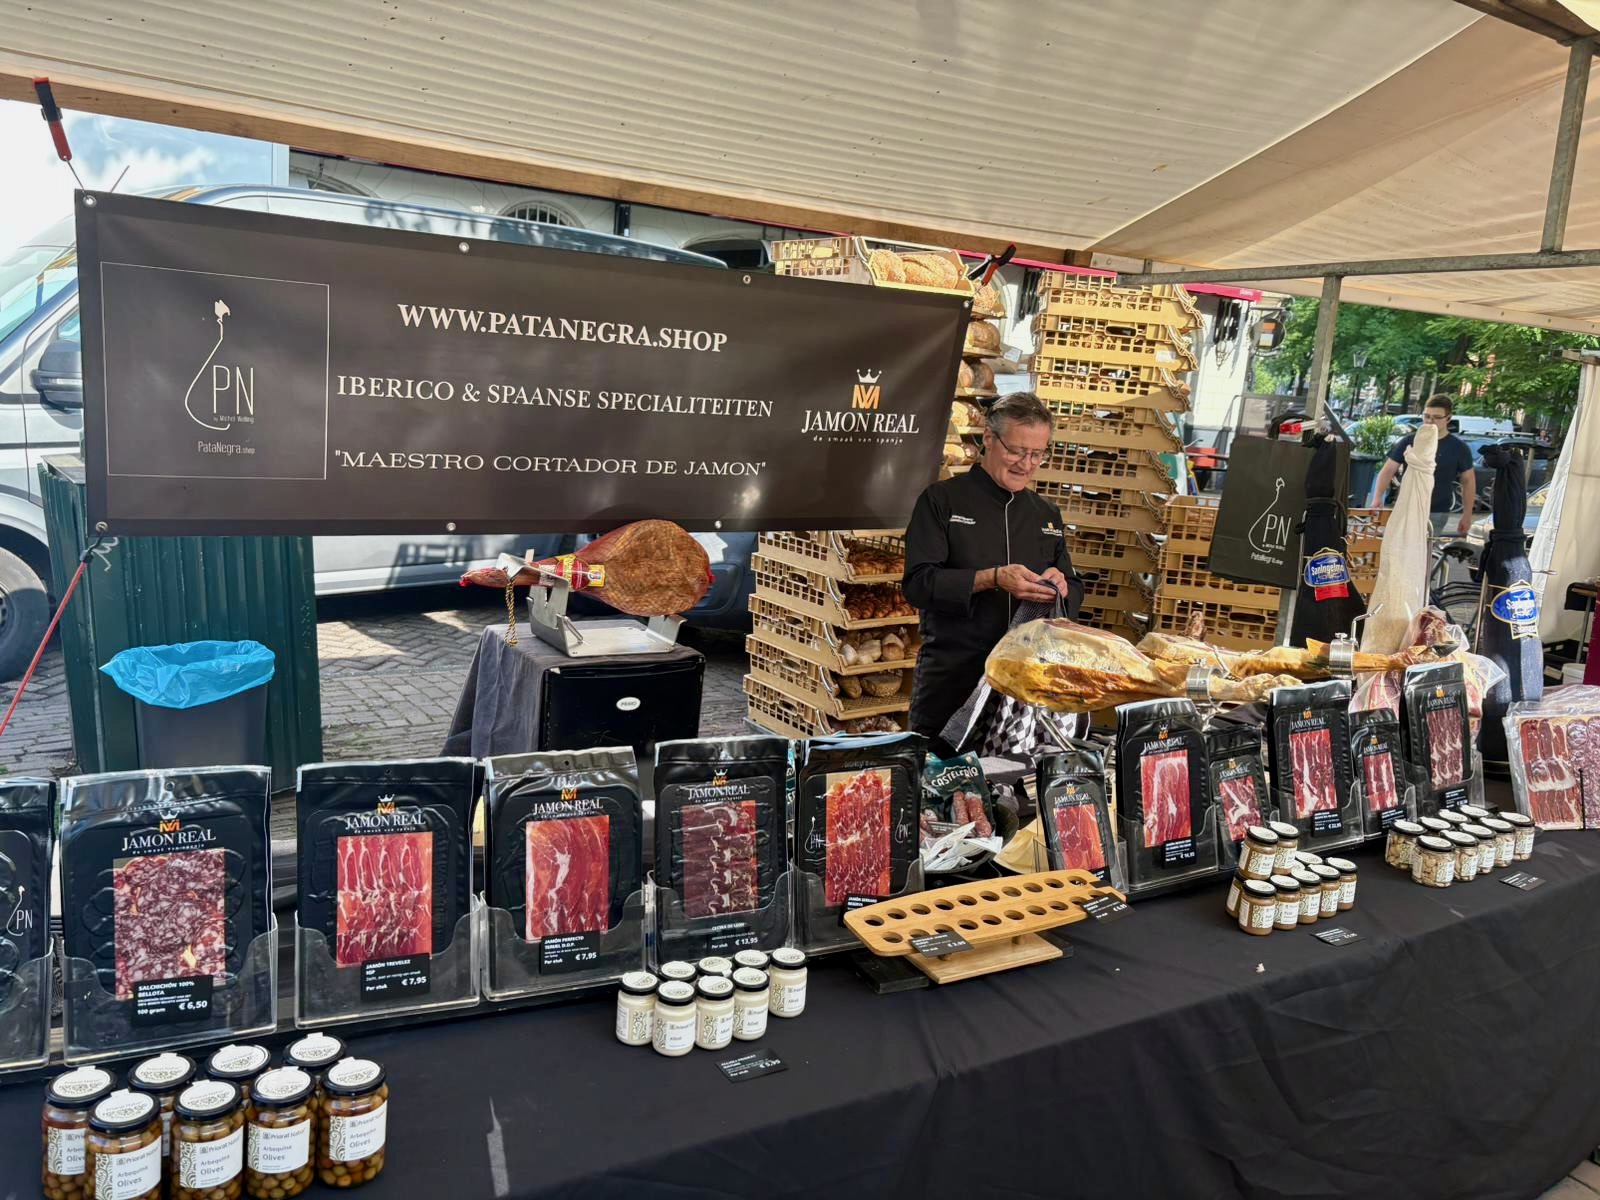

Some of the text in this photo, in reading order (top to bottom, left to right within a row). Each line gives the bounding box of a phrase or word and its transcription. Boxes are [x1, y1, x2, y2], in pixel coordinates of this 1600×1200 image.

[397, 303, 728, 352] WWW.PATANEGRA.SHOP
[213, 364, 254, 415] PN
[337, 375, 774, 417] IBERICO & SPAANSE SPECIALITEITEN
[801, 409, 919, 434] JAMON REAL
[335, 449, 766, 477] "MAESTRO CORTADOR DE JAMON"
[1262, 514, 1292, 546] PN
[688, 785, 724, 800] JAMON
[725, 784, 750, 796] REAL
[532, 800, 572, 815] JAMON
[575, 797, 604, 810] REAL
[345, 812, 426, 830] JAMON REAL
[121, 828, 216, 851] JAMON REAL
[16, 909, 33, 930] PN
[581, 952, 597, 961] 7,95
[409, 976, 427, 985] 7,95
[137, 990, 165, 998] BELLOTA
[179, 1002, 186, 1010] €
[187, 1000, 208, 1010] 6,50
[270, 1132, 290, 1140] Priorat
[208, 1142, 227, 1153] Priorat
[263, 1144, 292, 1152] Arbequina
[200, 1154, 230, 1166] Arbequina
[200, 1165, 225, 1176] Olives
[116, 1178, 142, 1188] Olives
